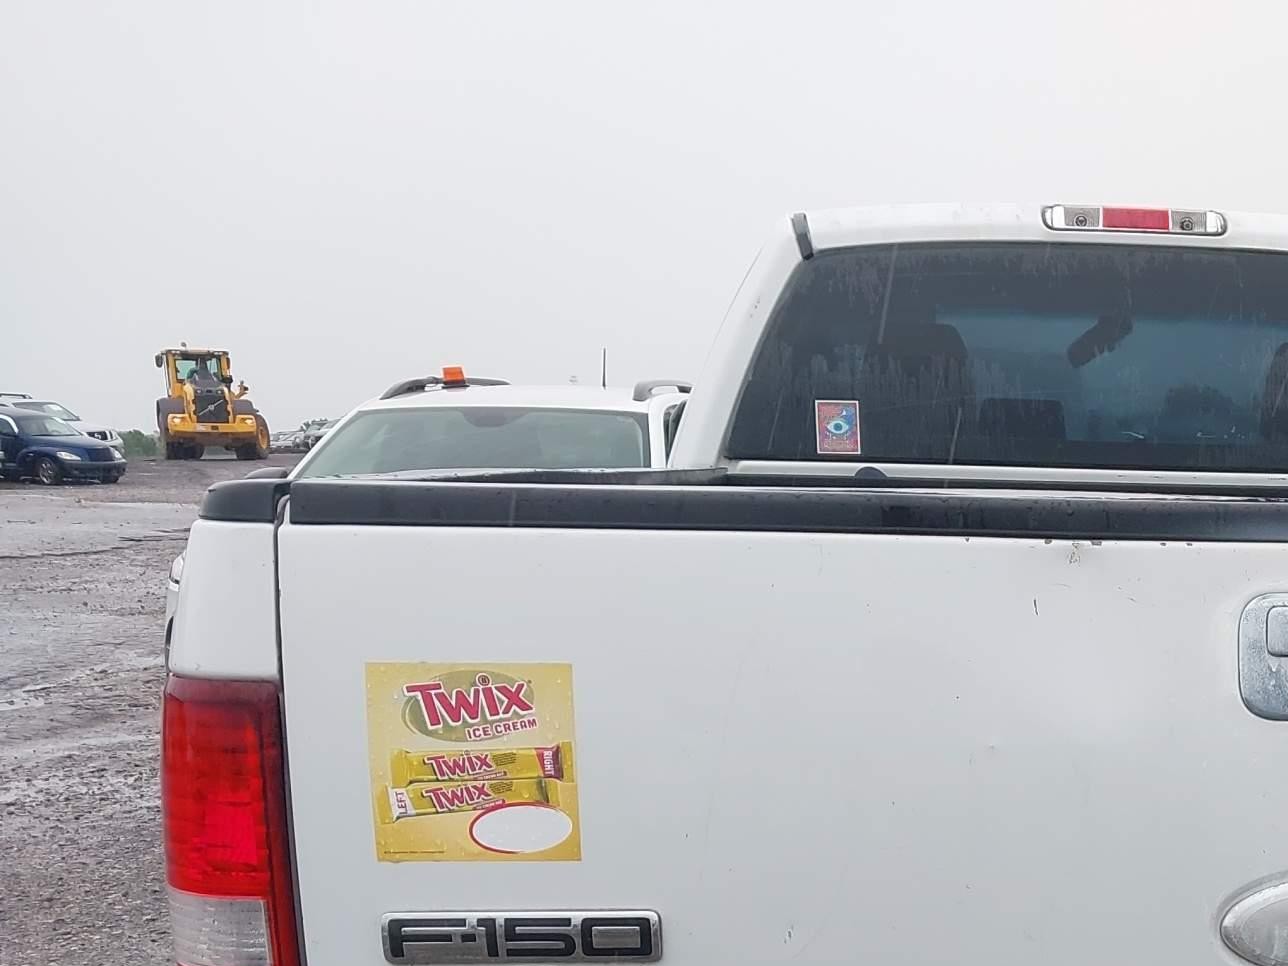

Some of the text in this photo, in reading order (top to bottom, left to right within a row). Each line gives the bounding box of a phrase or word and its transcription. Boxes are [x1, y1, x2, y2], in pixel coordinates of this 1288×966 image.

[466, 717, 538, 740] ICE CREAM
[543, 750, 555, 777] RIGHT
[395, 792, 408, 815] LEFT
[388, 917, 652, 958] F-150
